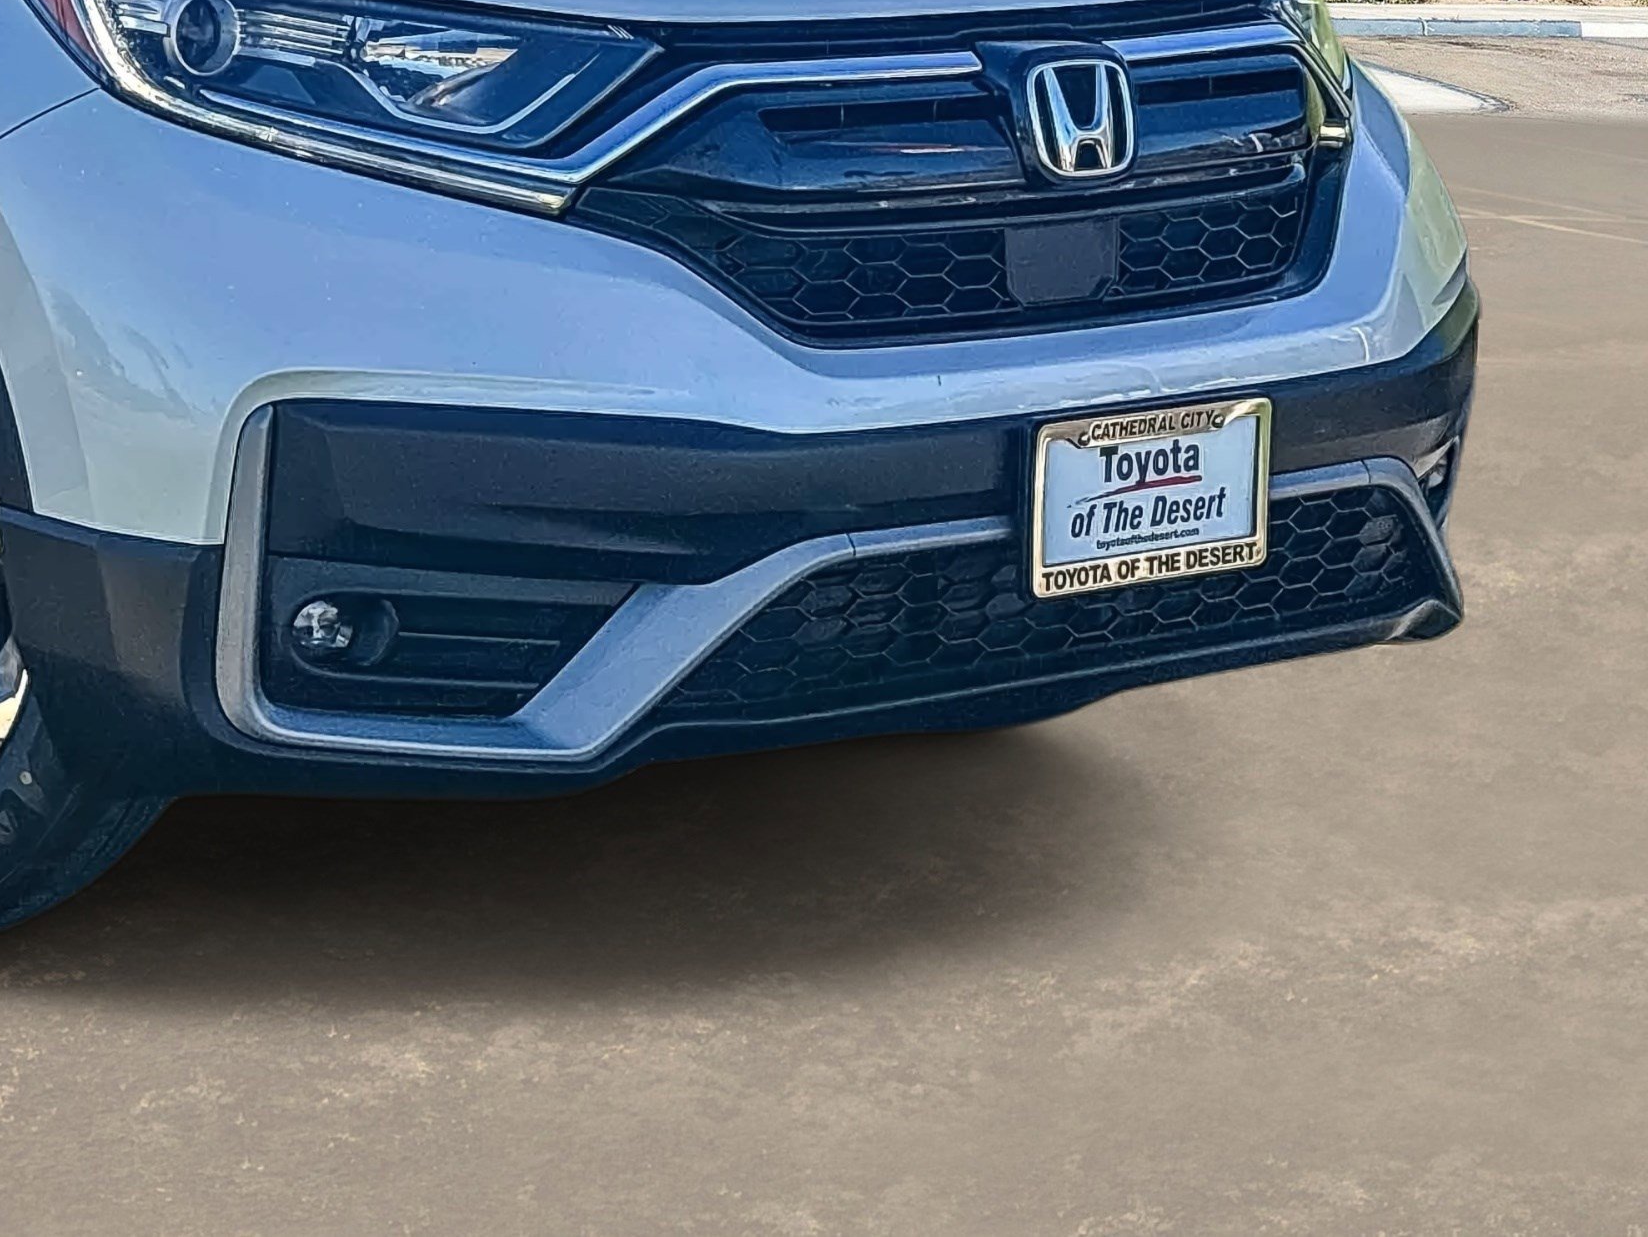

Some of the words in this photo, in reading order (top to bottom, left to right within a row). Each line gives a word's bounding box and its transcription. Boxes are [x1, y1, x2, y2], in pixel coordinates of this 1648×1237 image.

[1091, 413, 1176, 440] CATHEDRAL
[1180, 409, 1215, 428] CITY
[1099, 439, 1200, 485] Toyota
[1070, 503, 1098, 538] of
[1102, 500, 1144, 534] The
[1150, 486, 1226, 528] Desert
[1042, 564, 1111, 592] TOYOTA
[1117, 558, 1141, 580] OF
[1145, 551, 1182, 574] THE
[1186, 542, 1257, 569] DESERT
